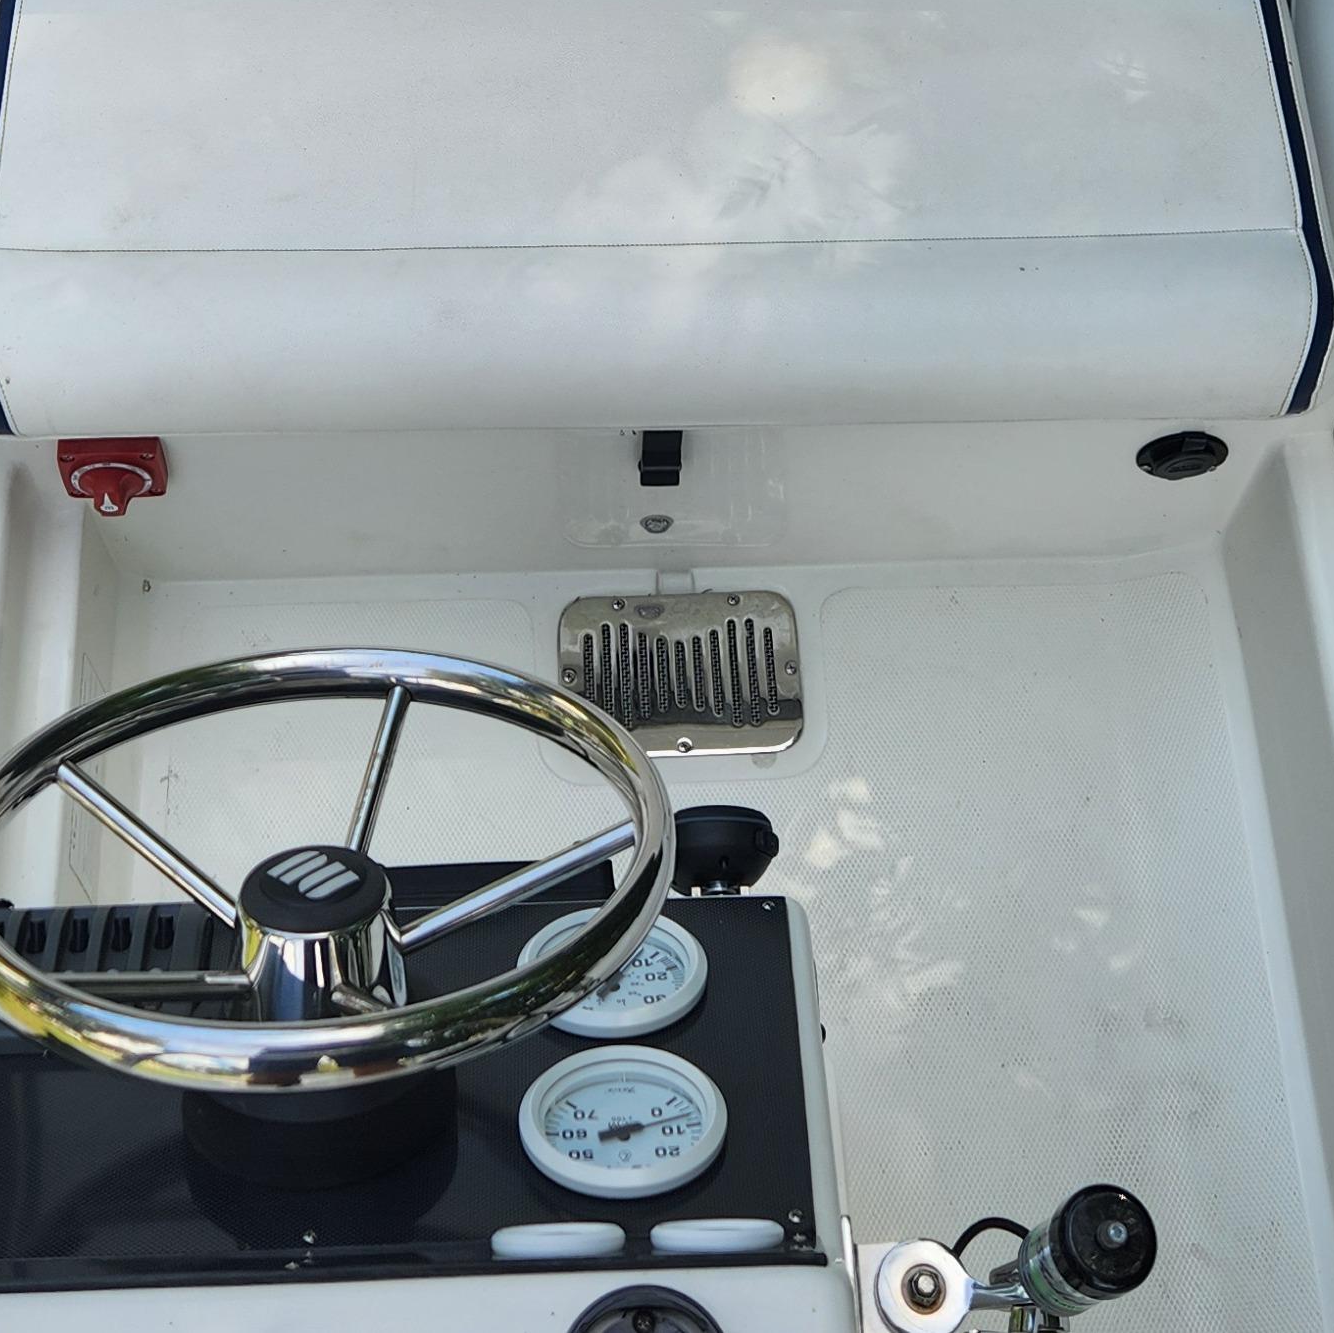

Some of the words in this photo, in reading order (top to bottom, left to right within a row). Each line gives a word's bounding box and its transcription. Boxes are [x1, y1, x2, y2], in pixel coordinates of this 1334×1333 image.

[645, 971, 668, 982] 20
[573, 1109, 598, 1121] 70
[650, 1106, 663, 1118] 0
[561, 1128, 588, 1140] 60
[661, 1125, 685, 1136] 10
[568, 1148, 594, 1161] 50
[655, 1146, 680, 1158] 20
